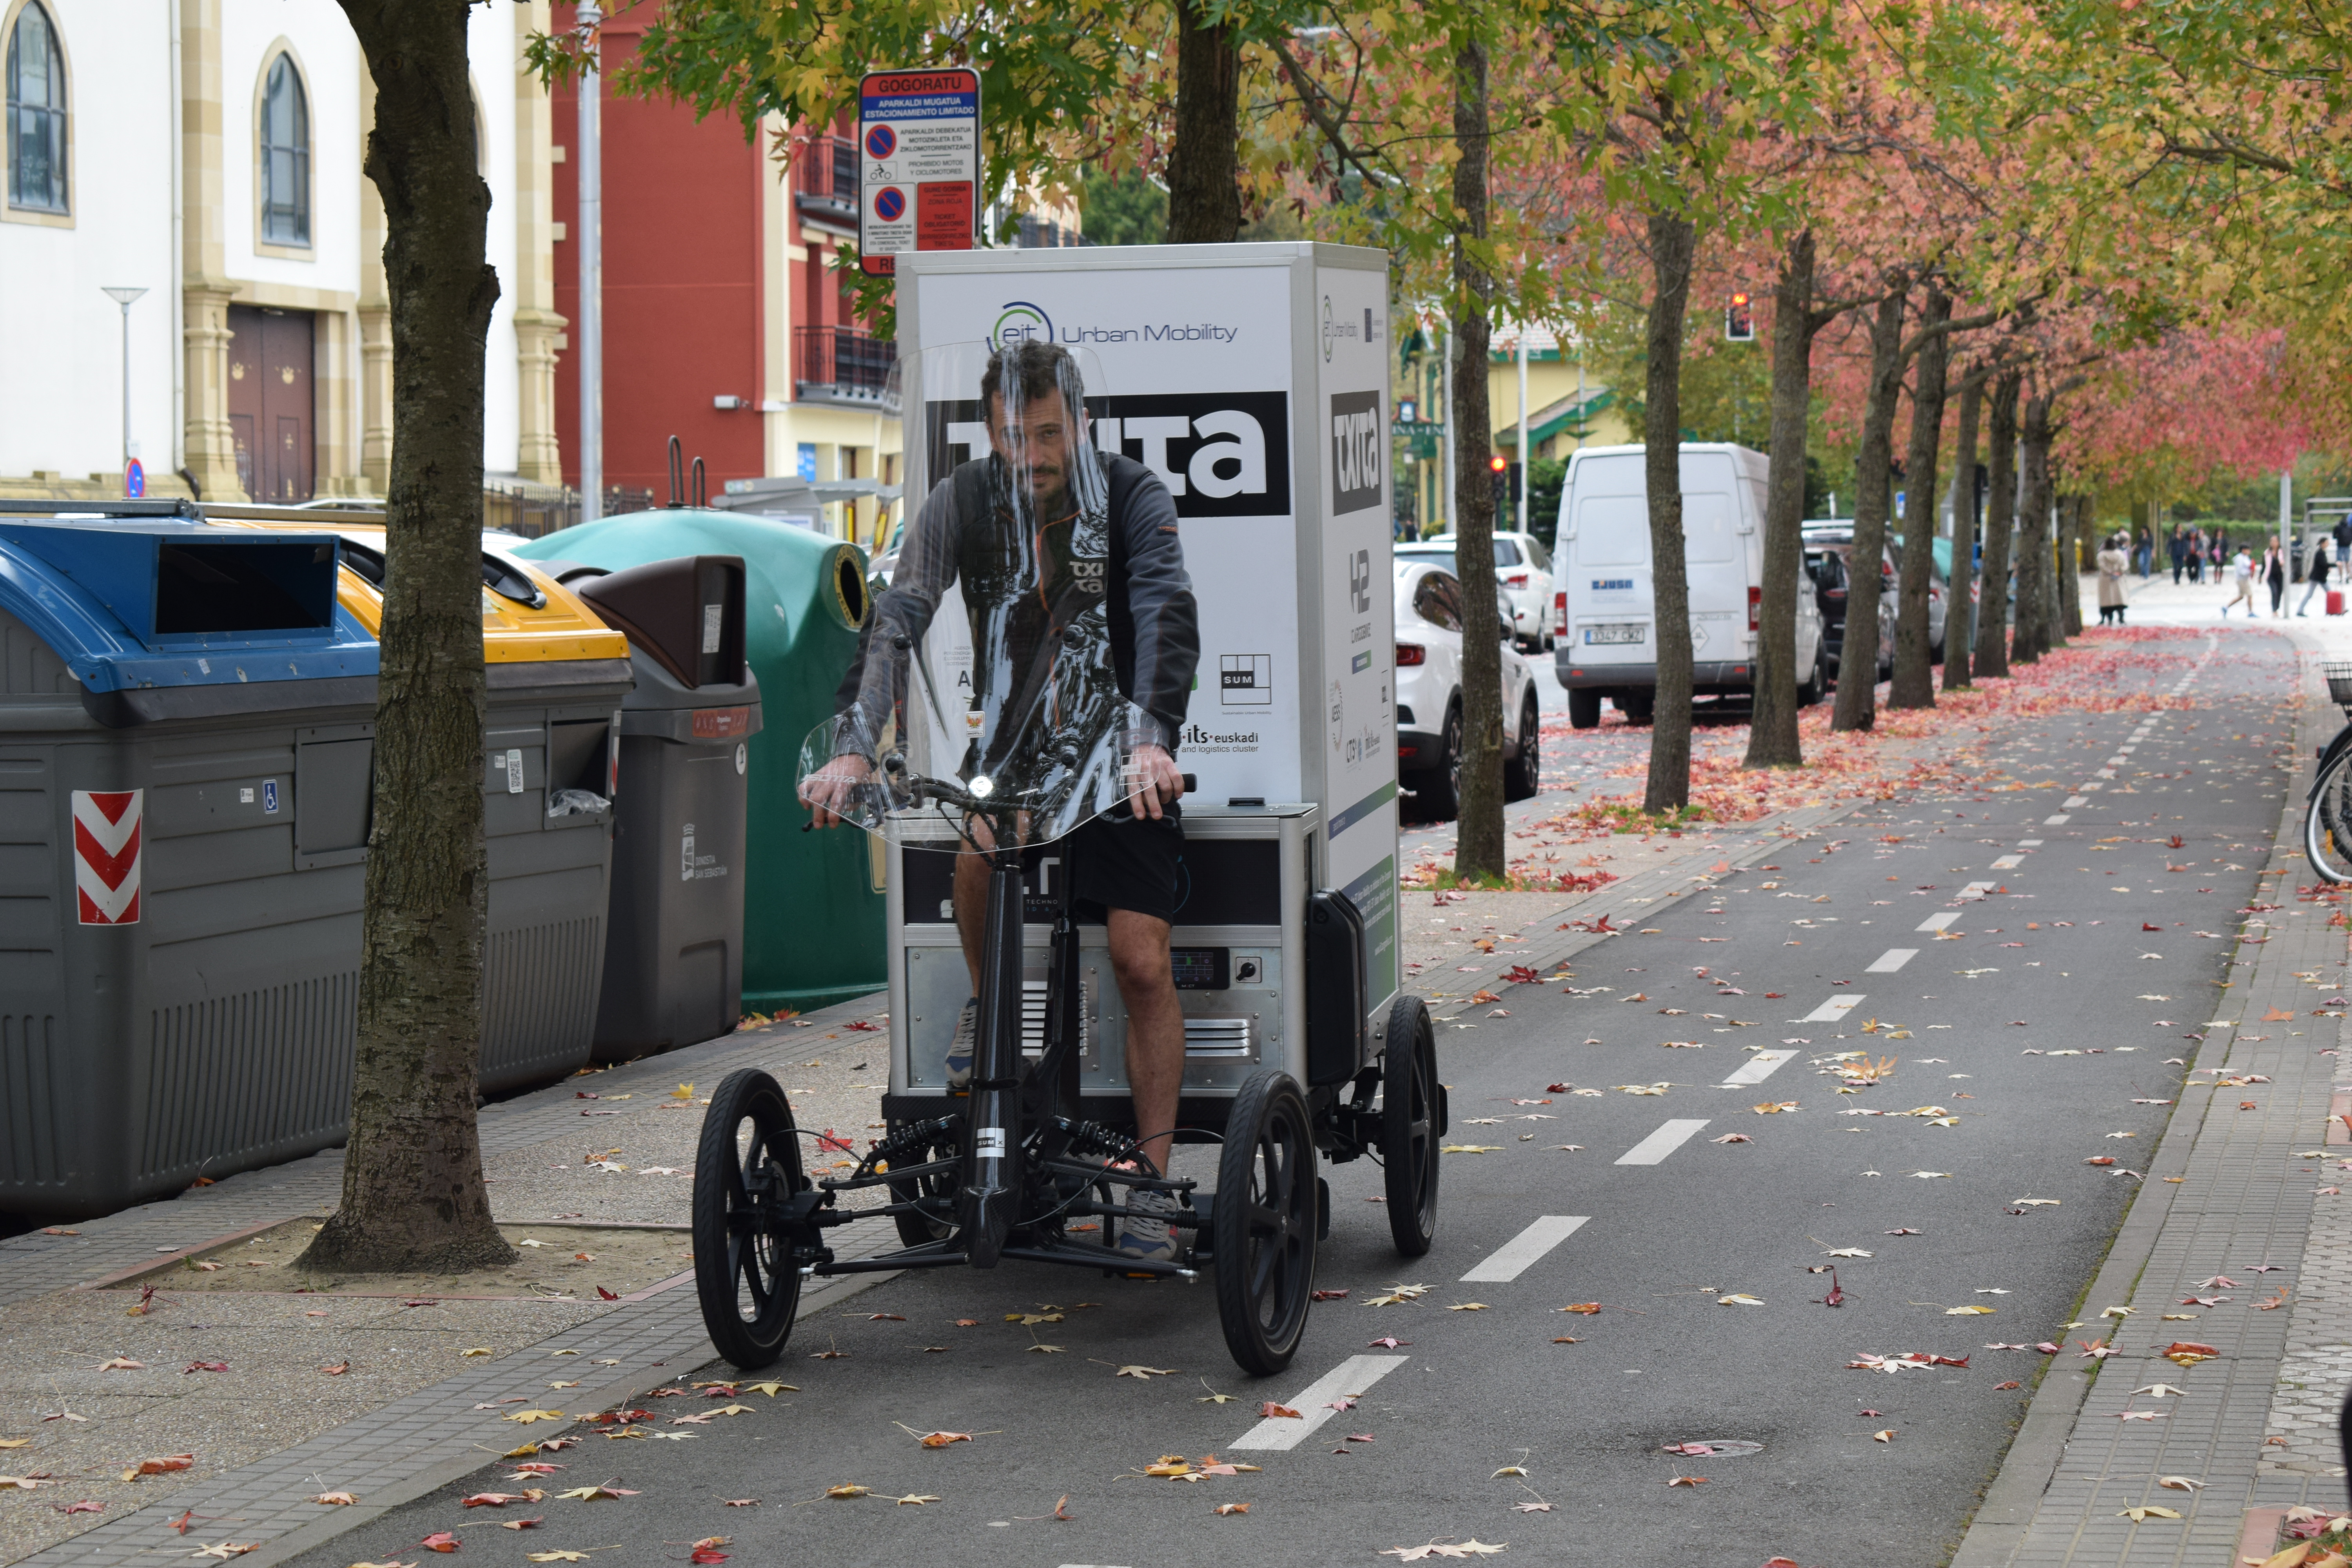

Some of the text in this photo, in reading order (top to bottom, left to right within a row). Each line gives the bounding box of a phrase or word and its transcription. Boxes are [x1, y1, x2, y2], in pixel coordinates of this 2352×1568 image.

[879, 77, 961, 93] GOGORATU
[878, 97, 961, 108] APARKALDI MUGATUA
[865, 106, 975, 118] ESTACIONAMIENTO LIMITADO
[900, 144, 972, 152] ZIKLOMOTORRENTZAKO
[1003, 323, 1238, 344] eit Urban Mobility
[1593, 630, 1617, 641] 3347
[1199, 745, 1230, 754] logistics
[801, 774, 857, 784] ISOTTA
[695, 869, 704, 879] SAN
